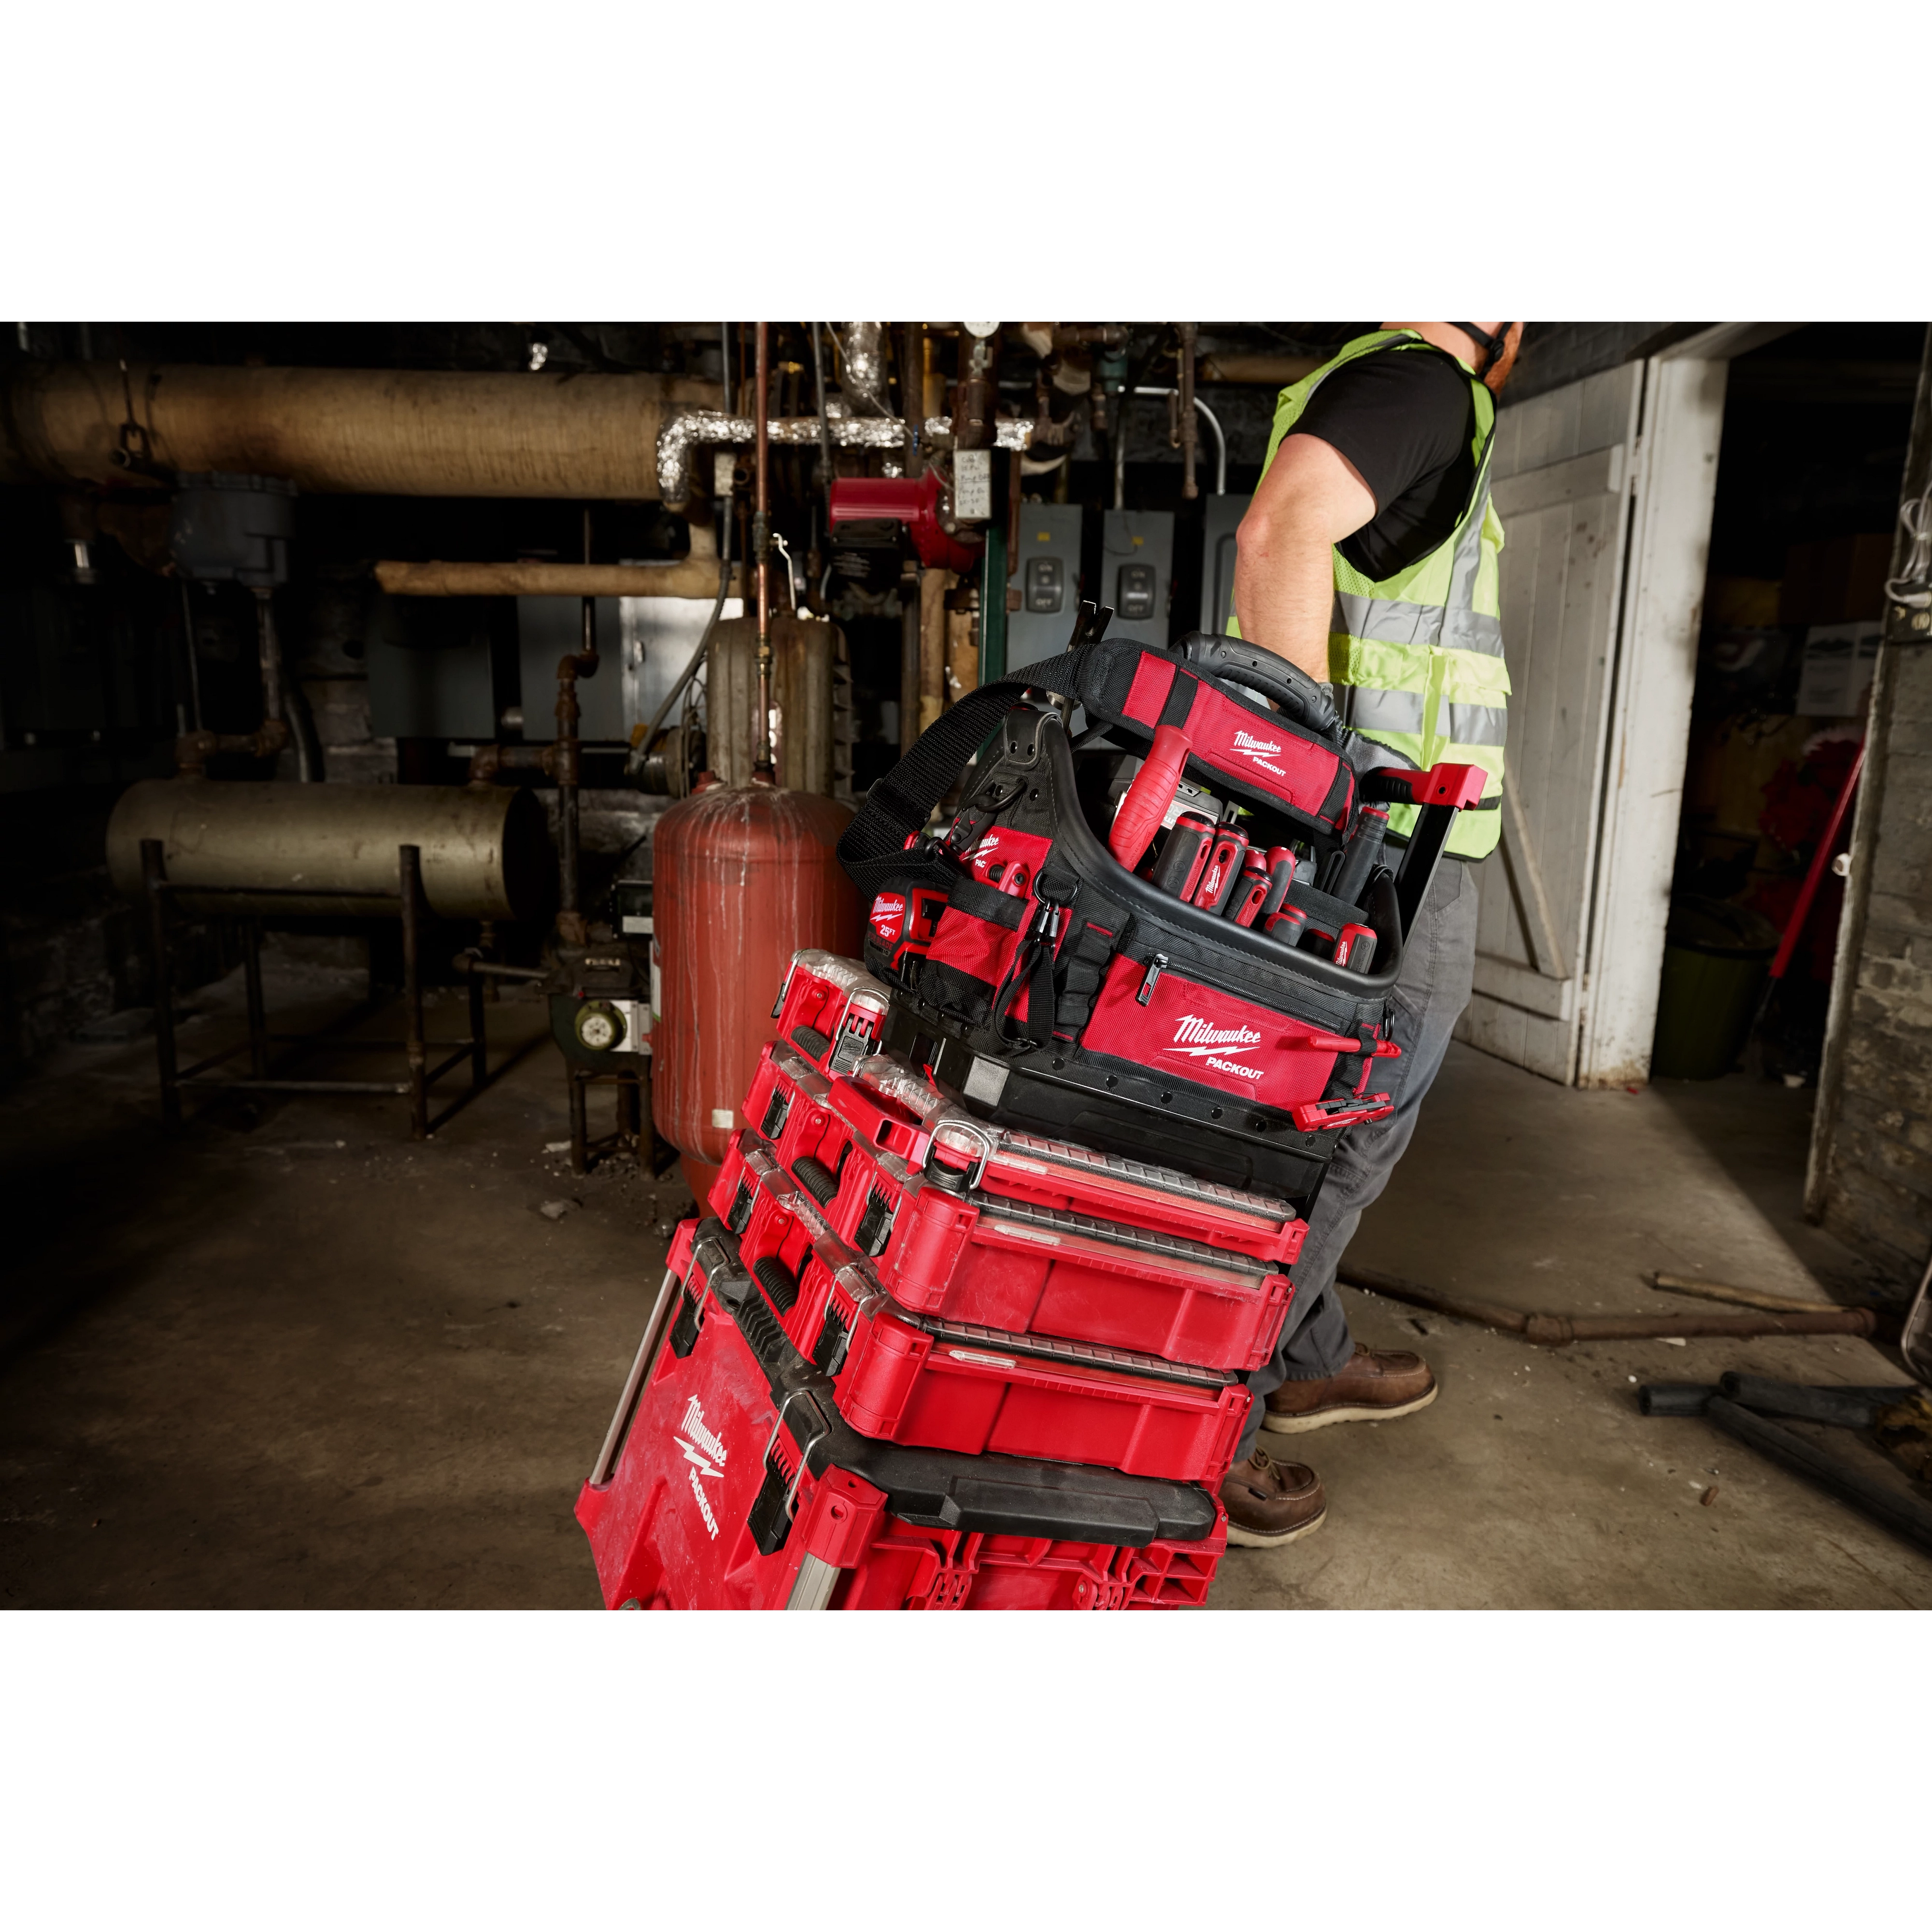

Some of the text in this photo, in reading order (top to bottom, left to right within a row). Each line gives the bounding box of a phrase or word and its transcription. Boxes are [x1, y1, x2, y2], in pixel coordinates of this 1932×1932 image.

[1234, 730, 1281, 753] Milwaukee
[1252, 756, 1287, 777] PACKOUT
[1205, 865, 1219, 894] Milwaukee
[873, 895, 903, 914] Milwaukee
[1173, 1014, 1261, 1044] Milwaukee
[1206, 1056, 1264, 1080] PACKOUT
[681, 1394, 727, 1467] Milwaukee
[689, 1466, 719, 1541] PACKOUT
